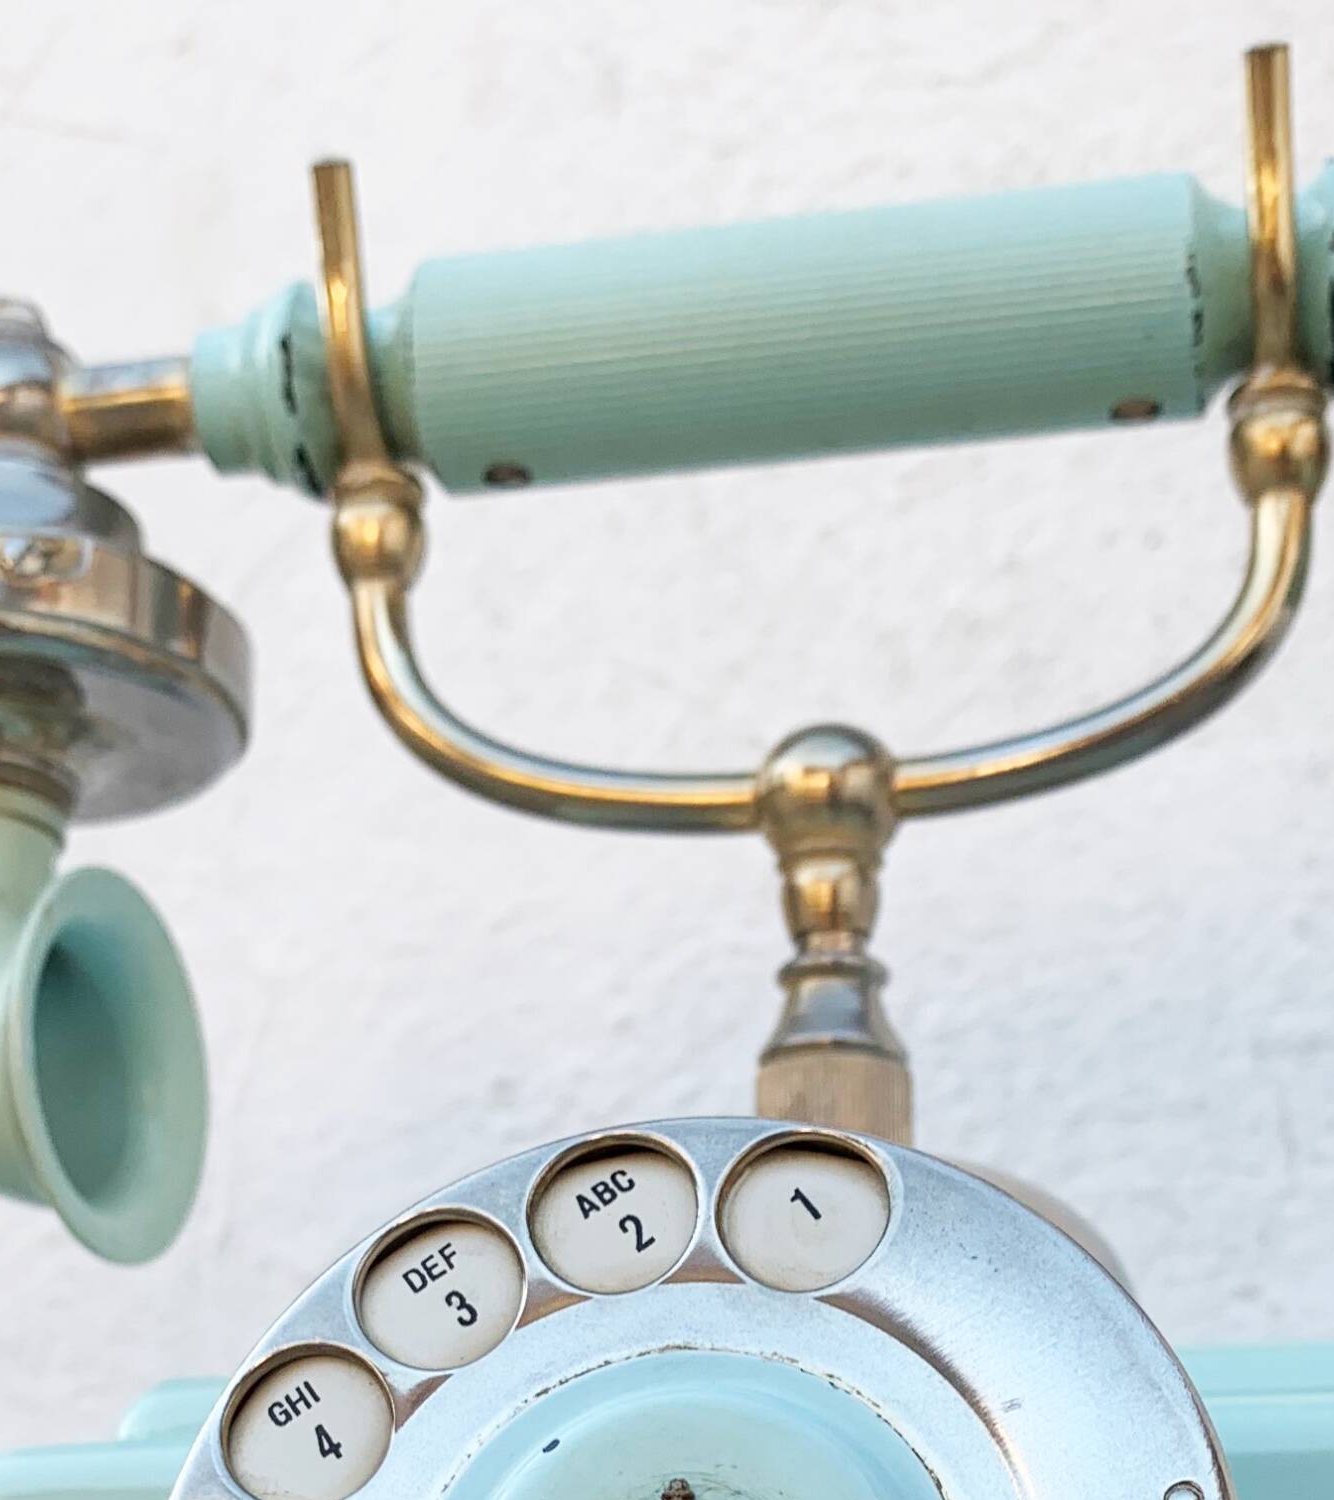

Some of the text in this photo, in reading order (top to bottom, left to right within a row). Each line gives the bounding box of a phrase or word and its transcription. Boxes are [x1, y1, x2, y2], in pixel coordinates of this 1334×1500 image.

[575, 1168, 636, 1220] ABC
[790, 1187, 822, 1221] 1
[618, 1214, 656, 1253] 2
[401, 1242, 460, 1295] DEF
[444, 1290, 478, 1327] 3
[267, 1380, 321, 1427] GHI
[314, 1424, 343, 1460] 4
